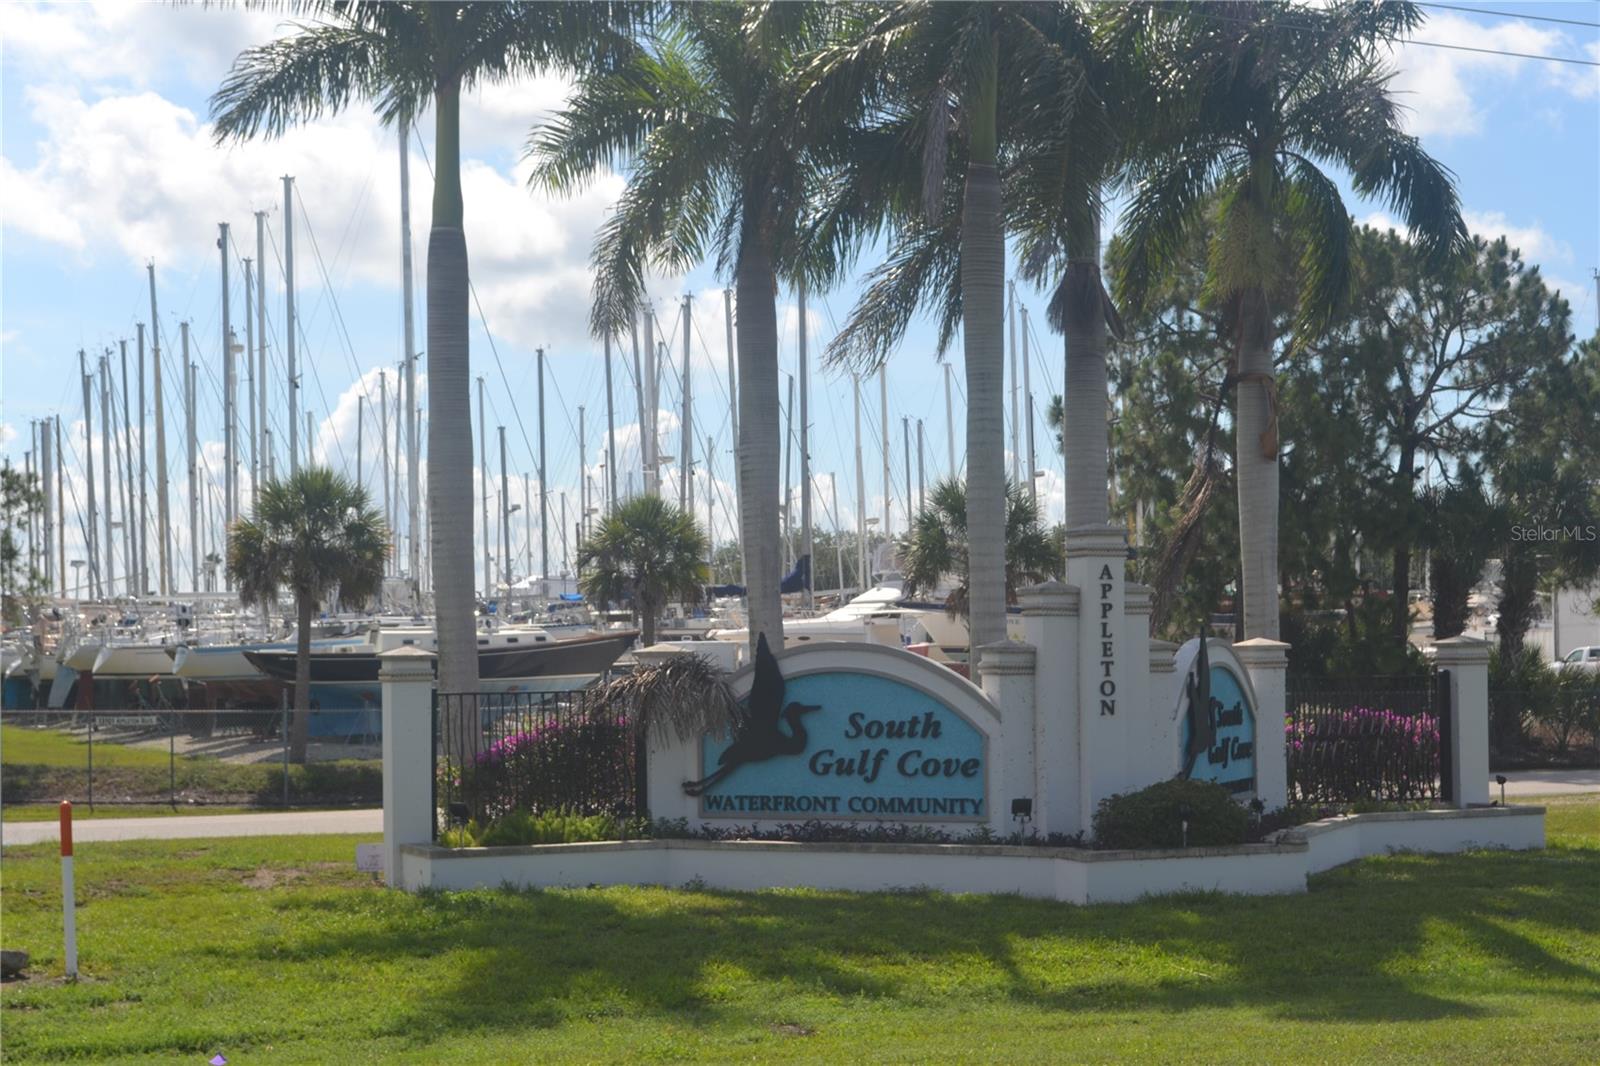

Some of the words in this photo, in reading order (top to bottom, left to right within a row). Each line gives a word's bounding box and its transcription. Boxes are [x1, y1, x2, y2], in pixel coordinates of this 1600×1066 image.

[1099, 563, 1116, 716] APPLETON
[845, 712, 942, 739] South
[808, 749, 888, 783] Gulf
[897, 750, 980, 777] Cove
[704, 795, 840, 812] WATERFRONT
[847, 796, 983, 815] COMMUNITY
